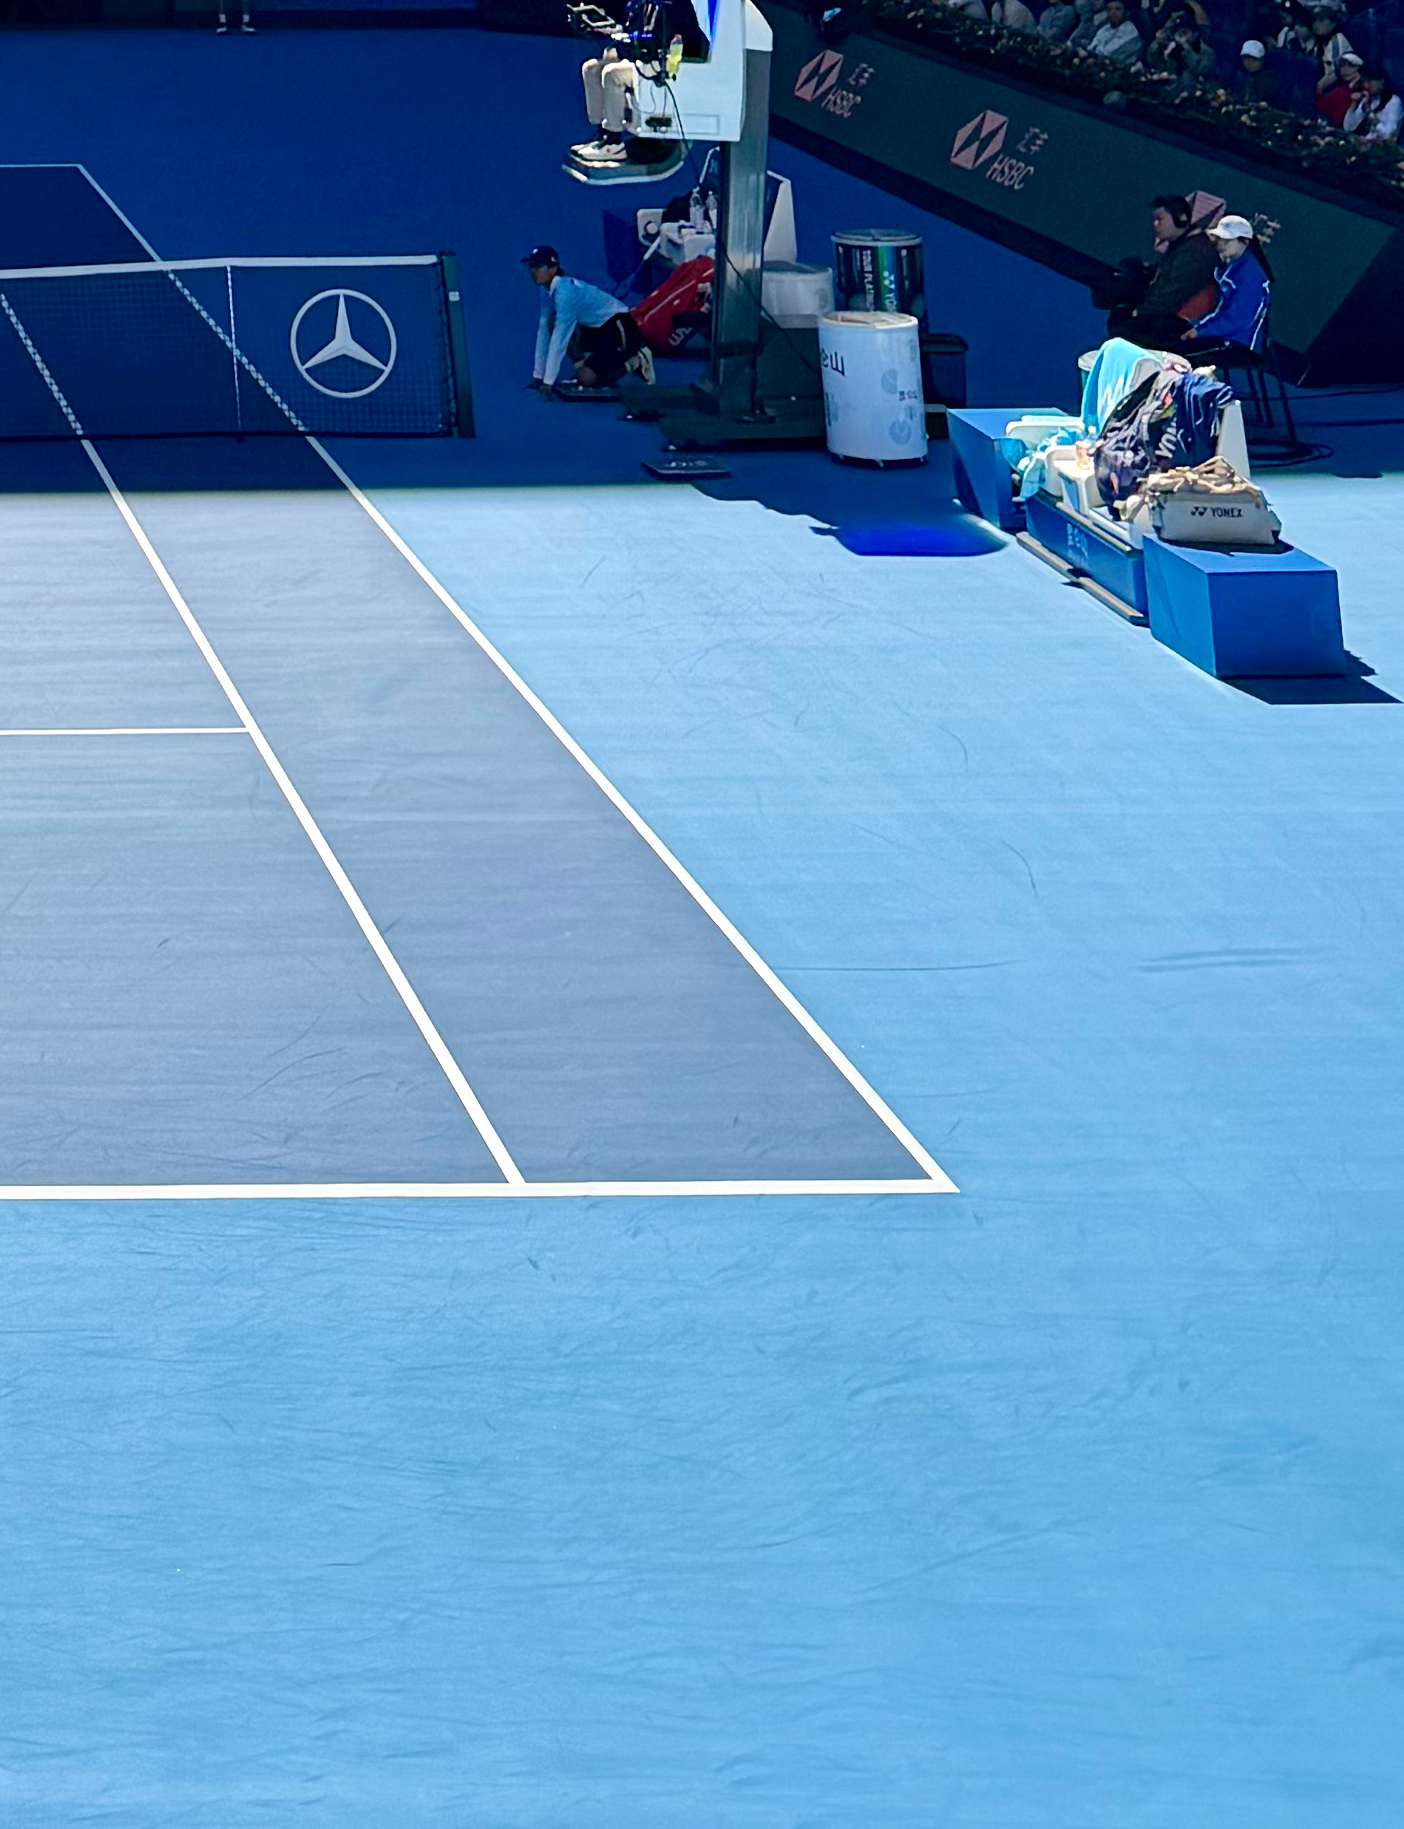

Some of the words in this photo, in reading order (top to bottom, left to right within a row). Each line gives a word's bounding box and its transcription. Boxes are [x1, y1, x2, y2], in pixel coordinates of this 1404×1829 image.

[821, 86, 862, 119] HSBC
[985, 153, 1035, 190] HSBC
[1211, 506, 1244, 518] YONEX
